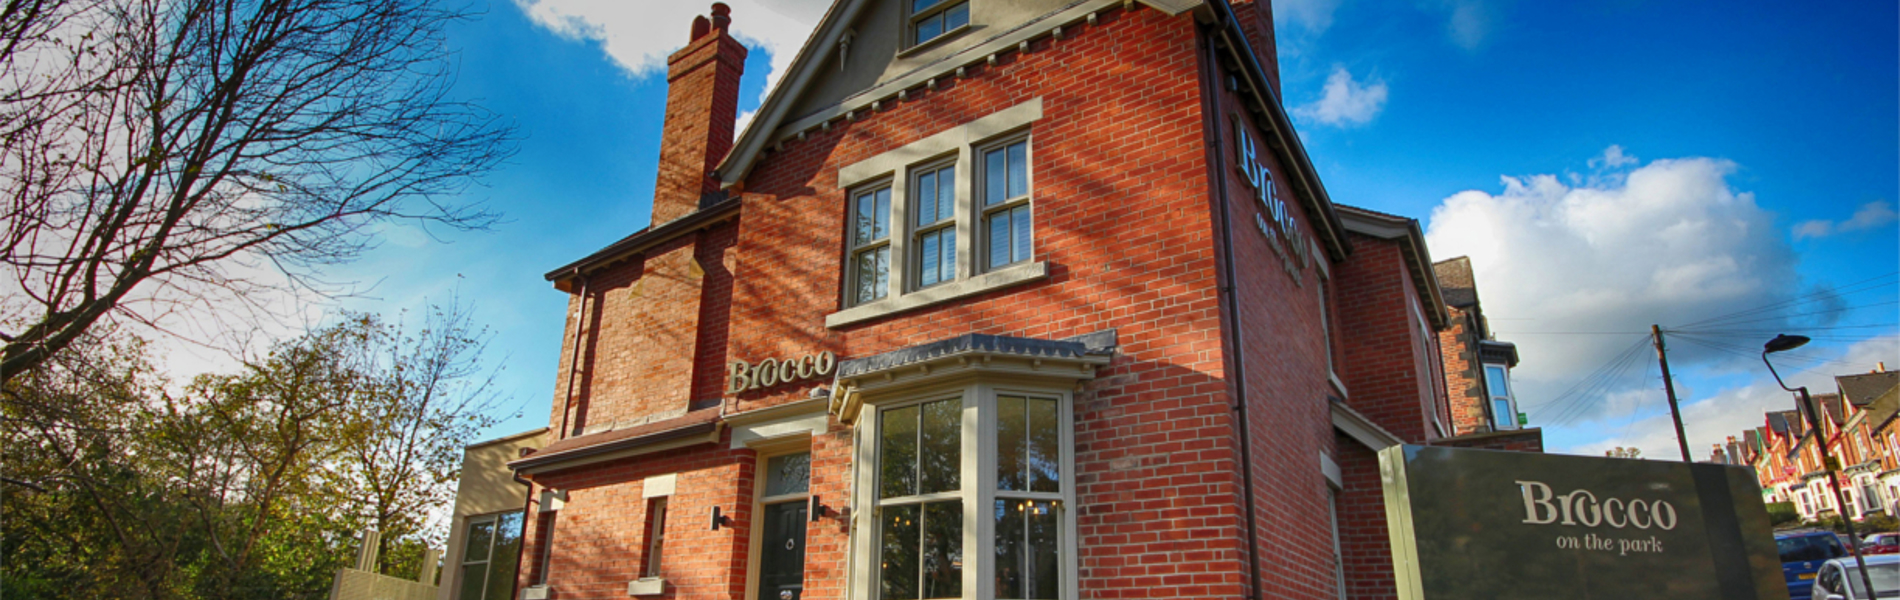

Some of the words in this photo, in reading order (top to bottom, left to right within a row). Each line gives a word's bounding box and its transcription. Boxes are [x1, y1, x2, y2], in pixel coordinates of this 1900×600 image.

[1230, 111, 1309, 269] Brocco
[724, 350, 837, 395] Brocco
[1515, 480, 1677, 530] Brocco
[1556, 535, 1580, 549] on
[1585, 533, 1614, 550] the
[1619, 536, 1663, 556] park
